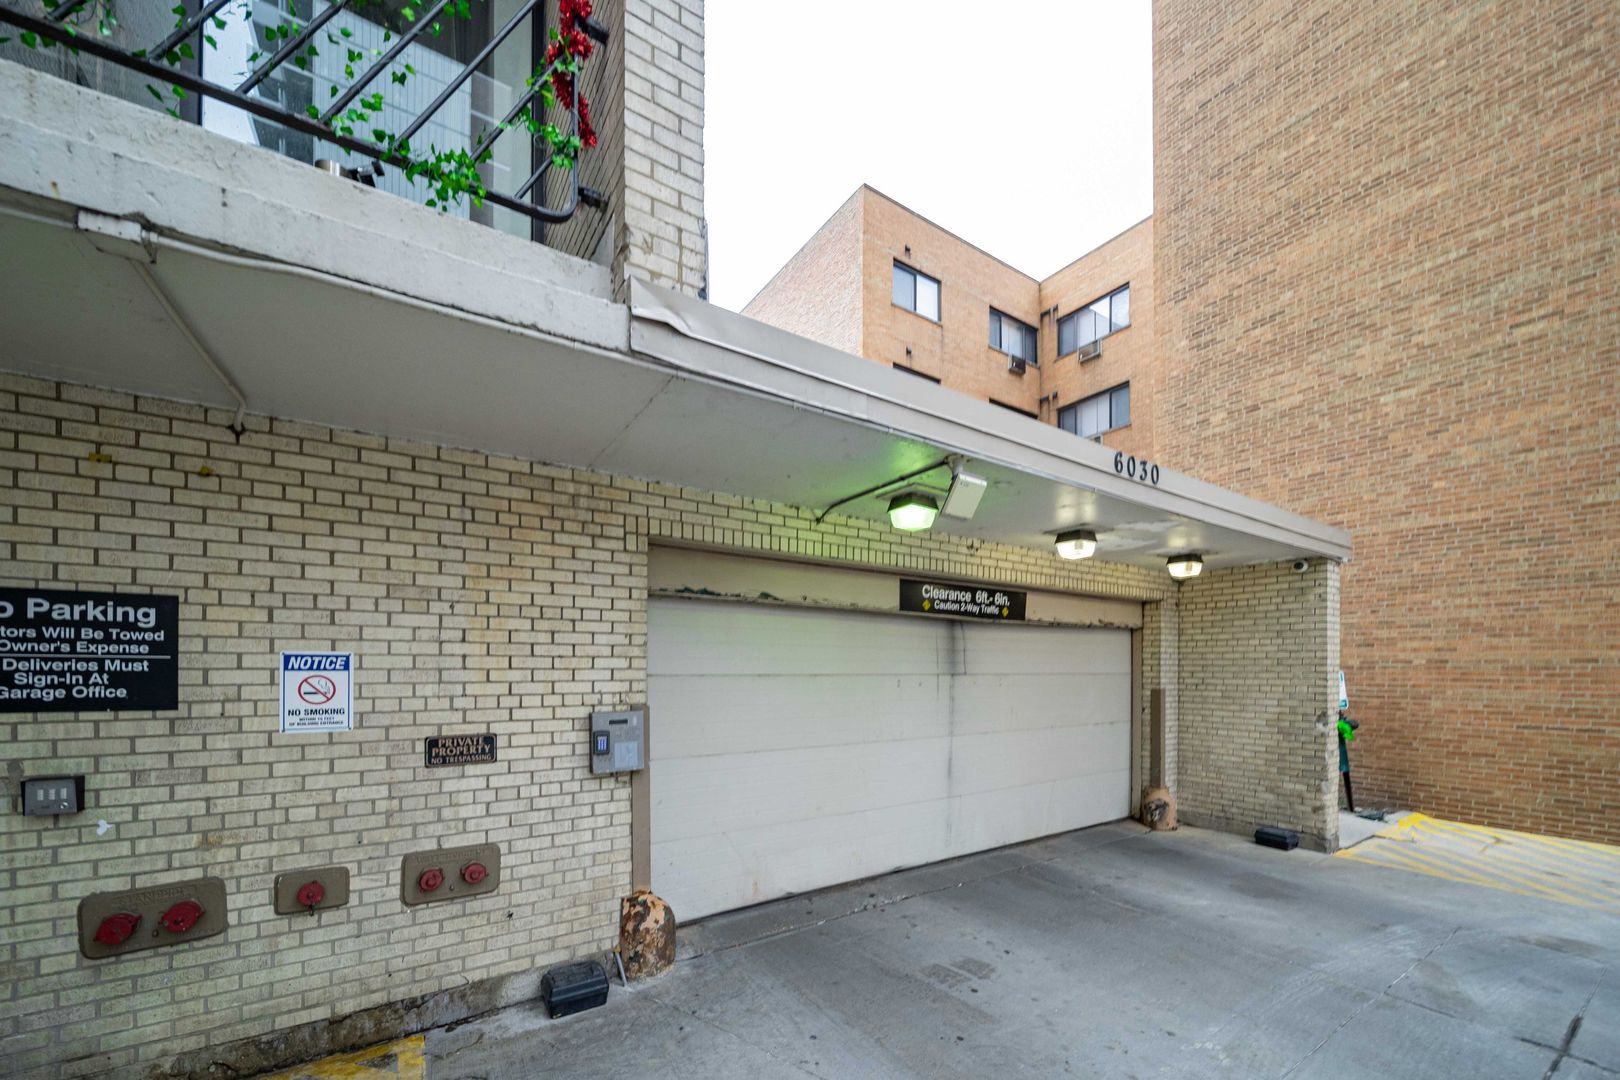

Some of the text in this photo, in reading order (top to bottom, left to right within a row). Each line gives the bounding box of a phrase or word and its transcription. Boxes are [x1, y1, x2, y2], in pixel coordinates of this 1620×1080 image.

[1114, 451, 1160, 485] 6030
[922, 584, 972, 602] Clearance
[26, 597, 157, 628] Parking
[934, 599, 1000, 615] Caution 2-Way Traffic
[0, 625, 165, 642] tors Will Be Towed
[0, 639, 150, 655] Owner's Expense
[2, 658, 149, 672] Deliveries Must
[287, 656, 346, 670] NOTICE
[14, 672, 109, 688] Sign-In At
[0, 685, 127, 702] Garage Office
[303, 707, 345, 716] SMOKING
[438, 736, 484, 748] PRIVATE
[431, 744, 491, 757] PROPERTY
[445, 754, 492, 763] TRESPASSING
